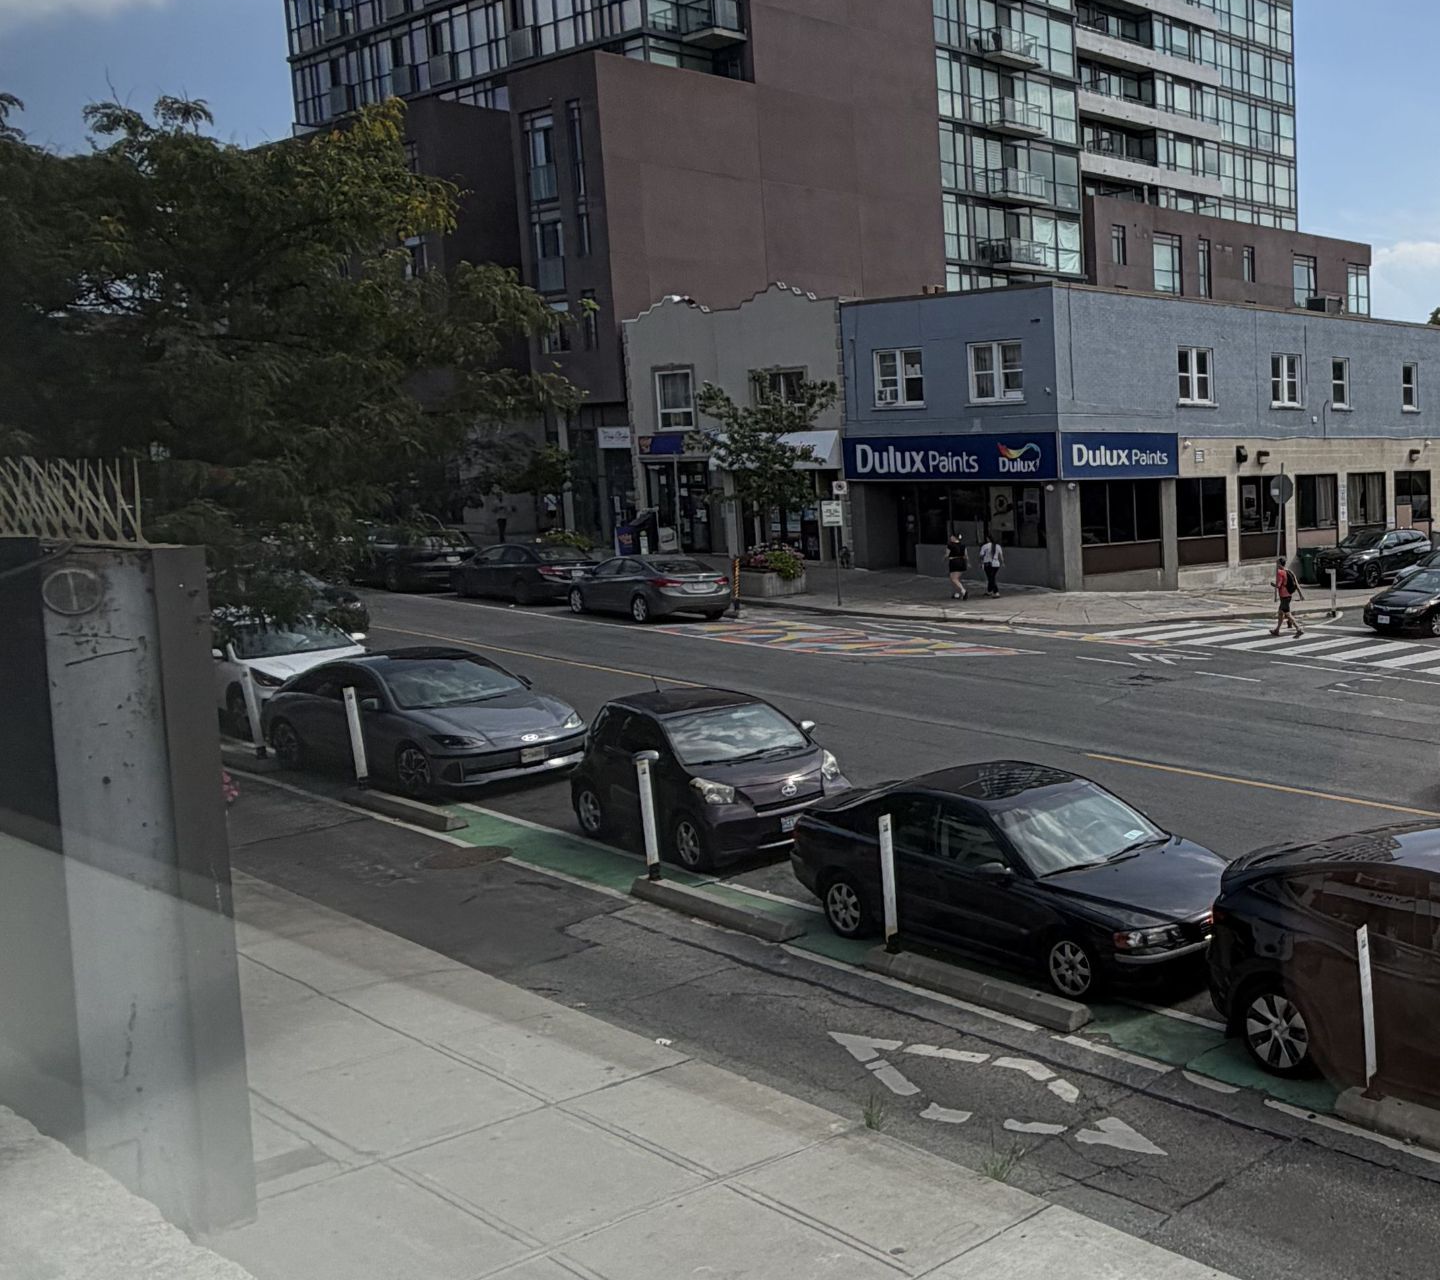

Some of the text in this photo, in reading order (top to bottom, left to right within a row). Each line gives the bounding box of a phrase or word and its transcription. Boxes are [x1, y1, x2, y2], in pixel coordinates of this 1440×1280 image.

[856, 444, 979, 474] Dulux Paints
[999, 456, 1039, 473] Dulux
[1072, 443, 1168, 467] Dulux Paints
